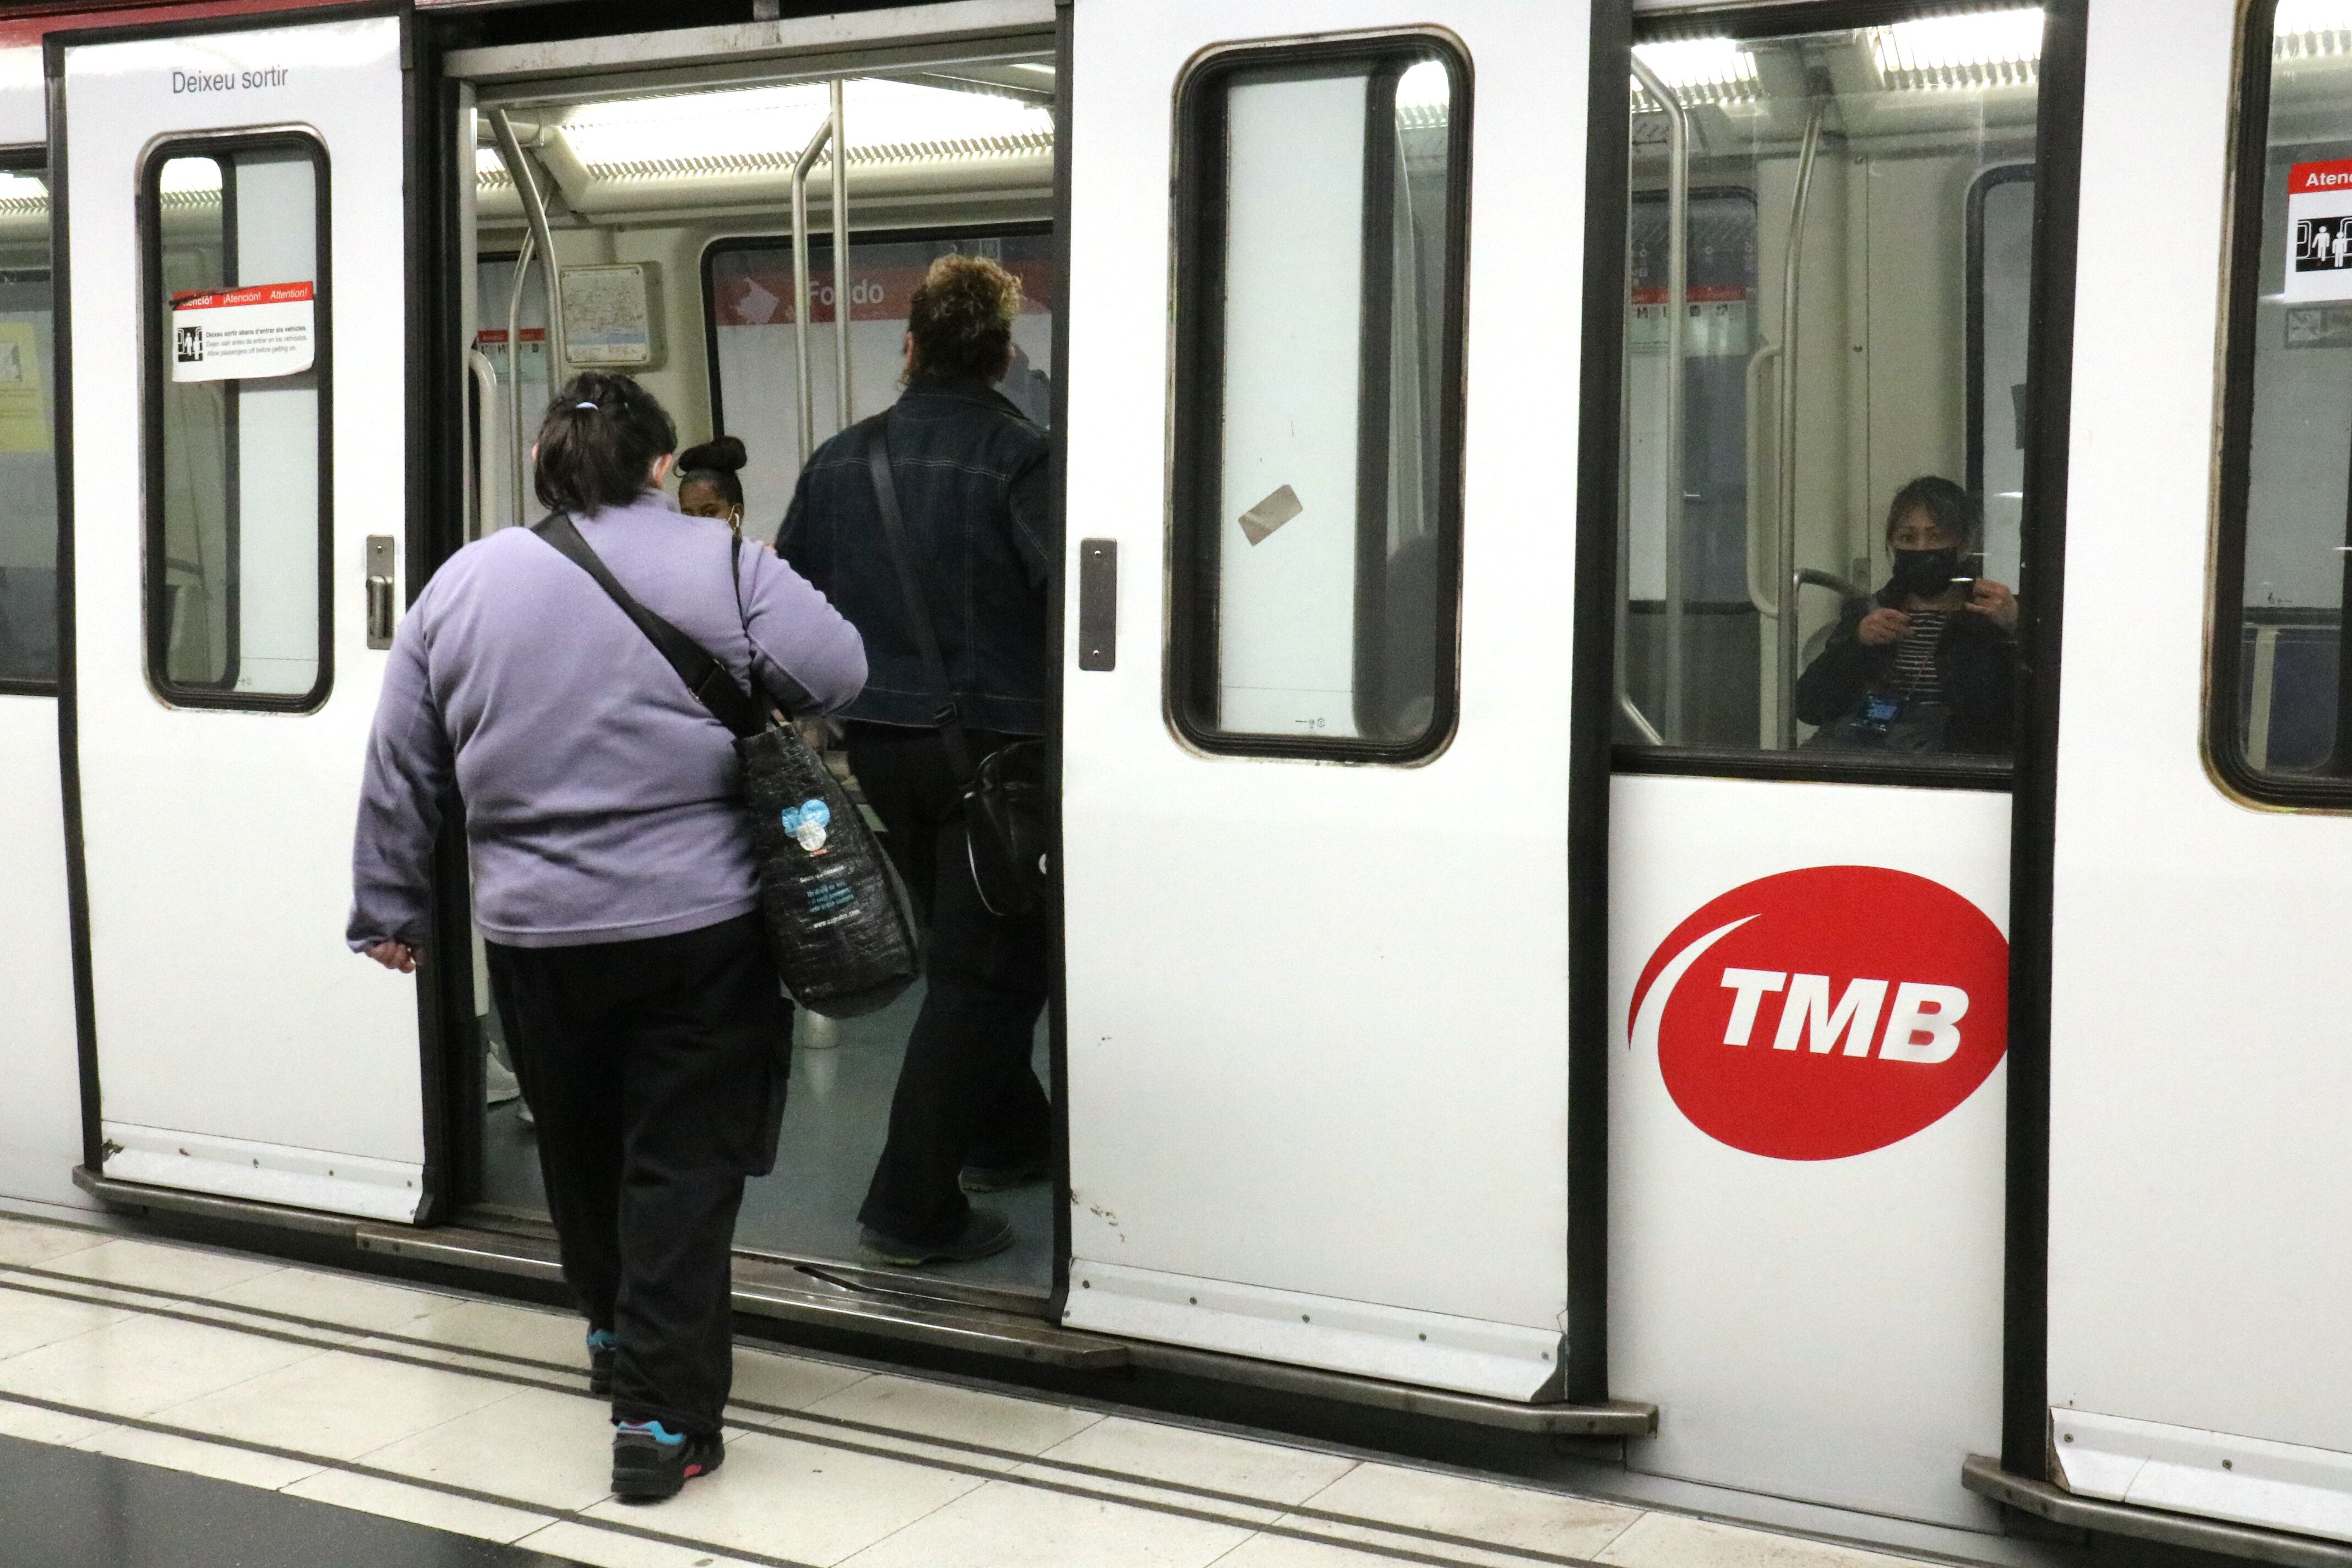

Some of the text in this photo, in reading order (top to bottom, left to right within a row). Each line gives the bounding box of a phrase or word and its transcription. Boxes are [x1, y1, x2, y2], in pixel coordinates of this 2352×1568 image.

[172, 64, 288, 94] Deixeu sortir
[223, 291, 262, 306] ¡Atención!
[270, 287, 307, 300] Attention!
[808, 277, 885, 306] Fodo
[1720, 967, 1970, 1064] TMB
